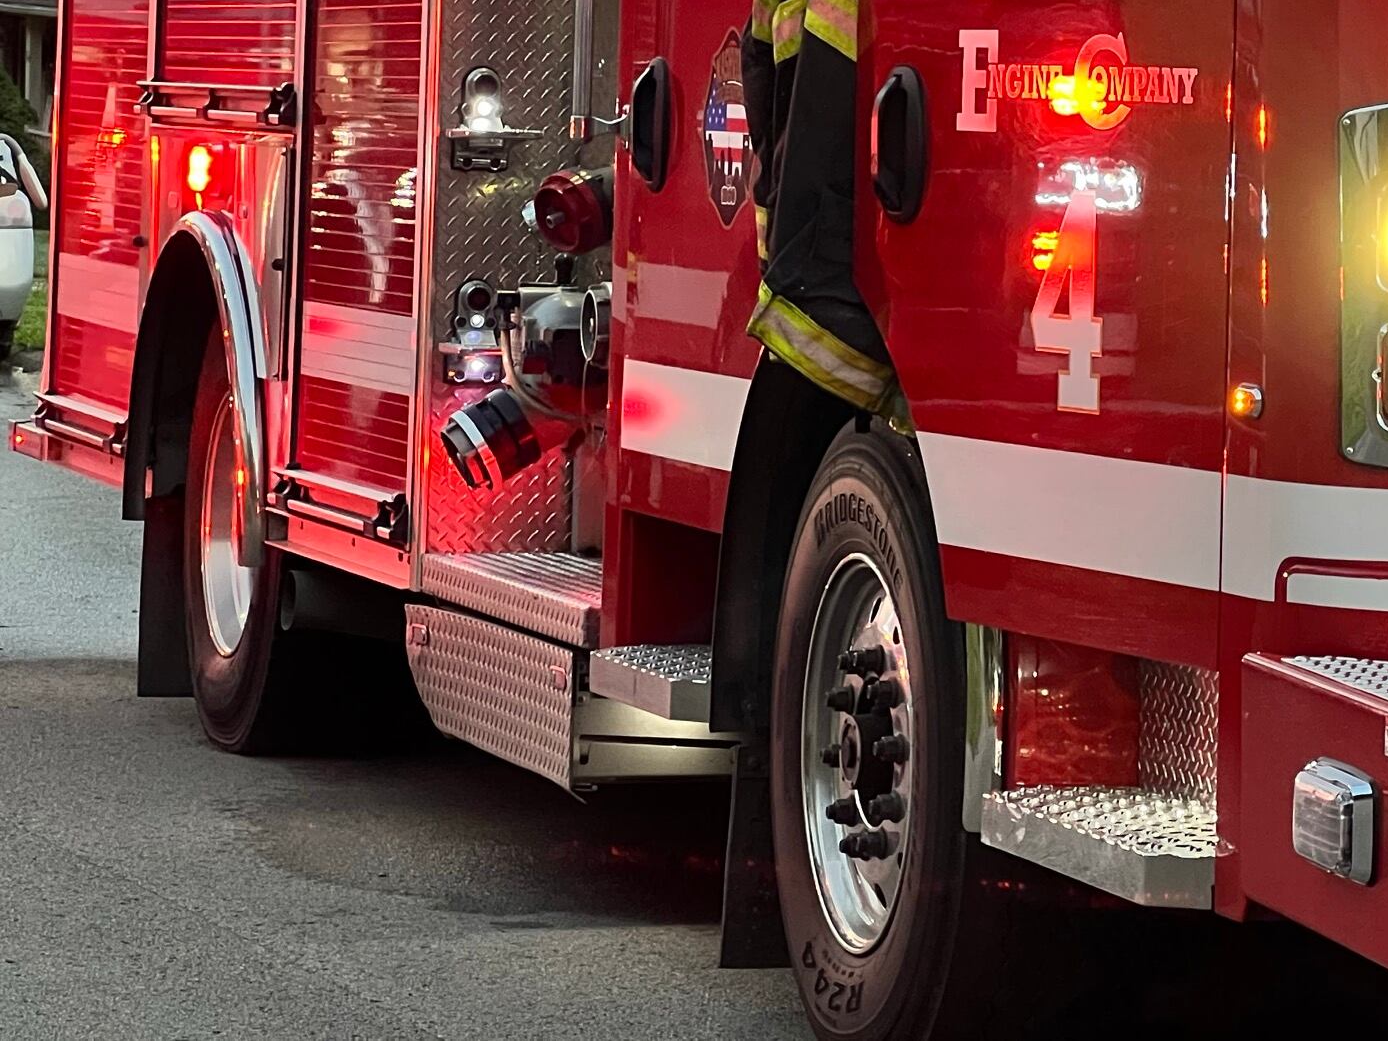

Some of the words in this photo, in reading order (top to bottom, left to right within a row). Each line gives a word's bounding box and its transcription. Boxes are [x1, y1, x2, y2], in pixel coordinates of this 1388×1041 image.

[1075, 32, 1198, 130] COMPANY
[1031, 190, 1104, 415] 4
[814, 492, 903, 592] BRIDGESTONE
